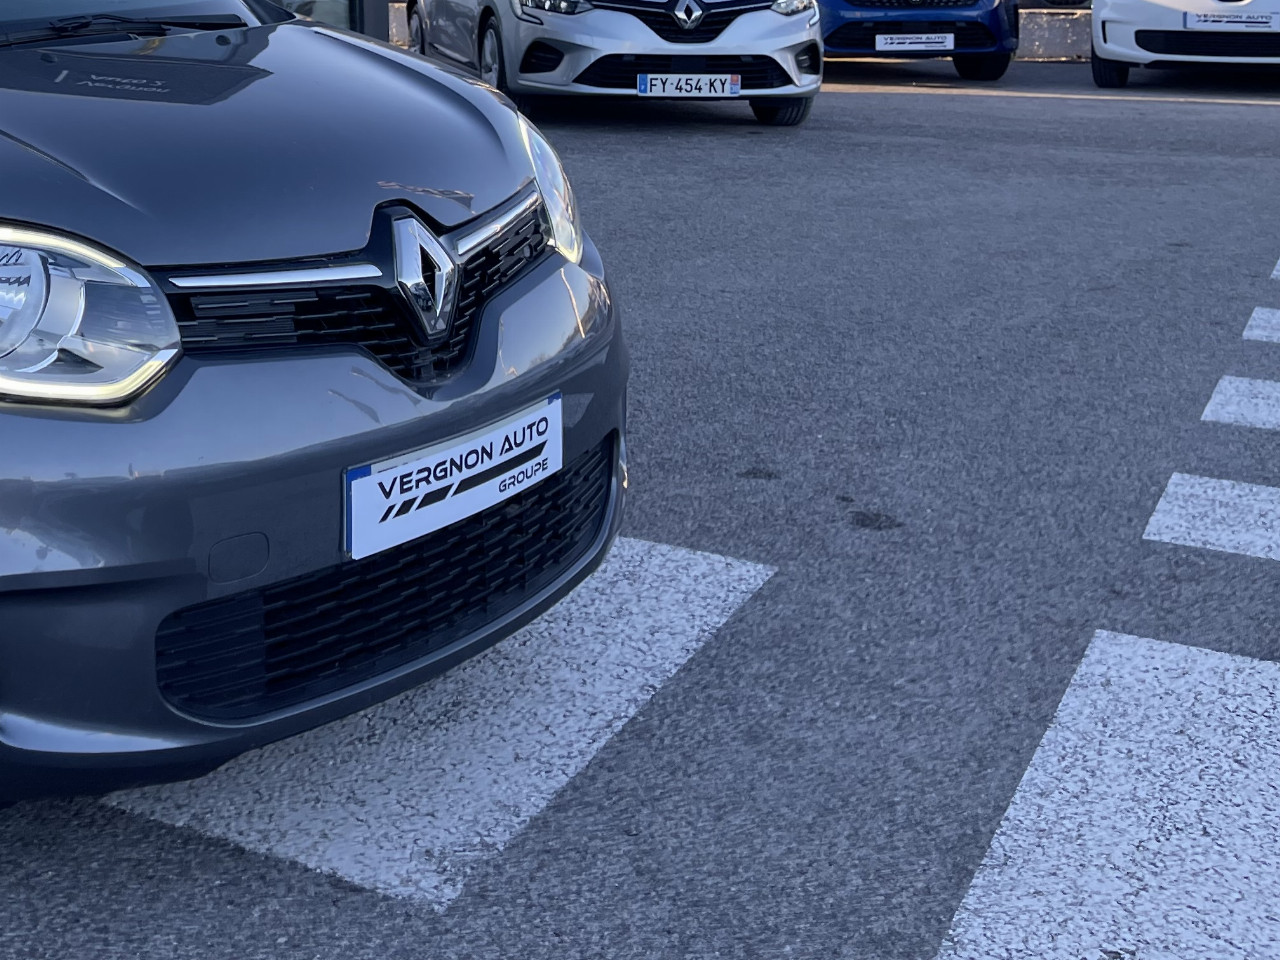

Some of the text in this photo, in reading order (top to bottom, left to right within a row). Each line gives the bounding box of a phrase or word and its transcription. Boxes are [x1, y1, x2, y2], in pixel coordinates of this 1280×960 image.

[377, 416, 550, 500] VERGNON AUTO
[497, 456, 550, 494] GROUPE
